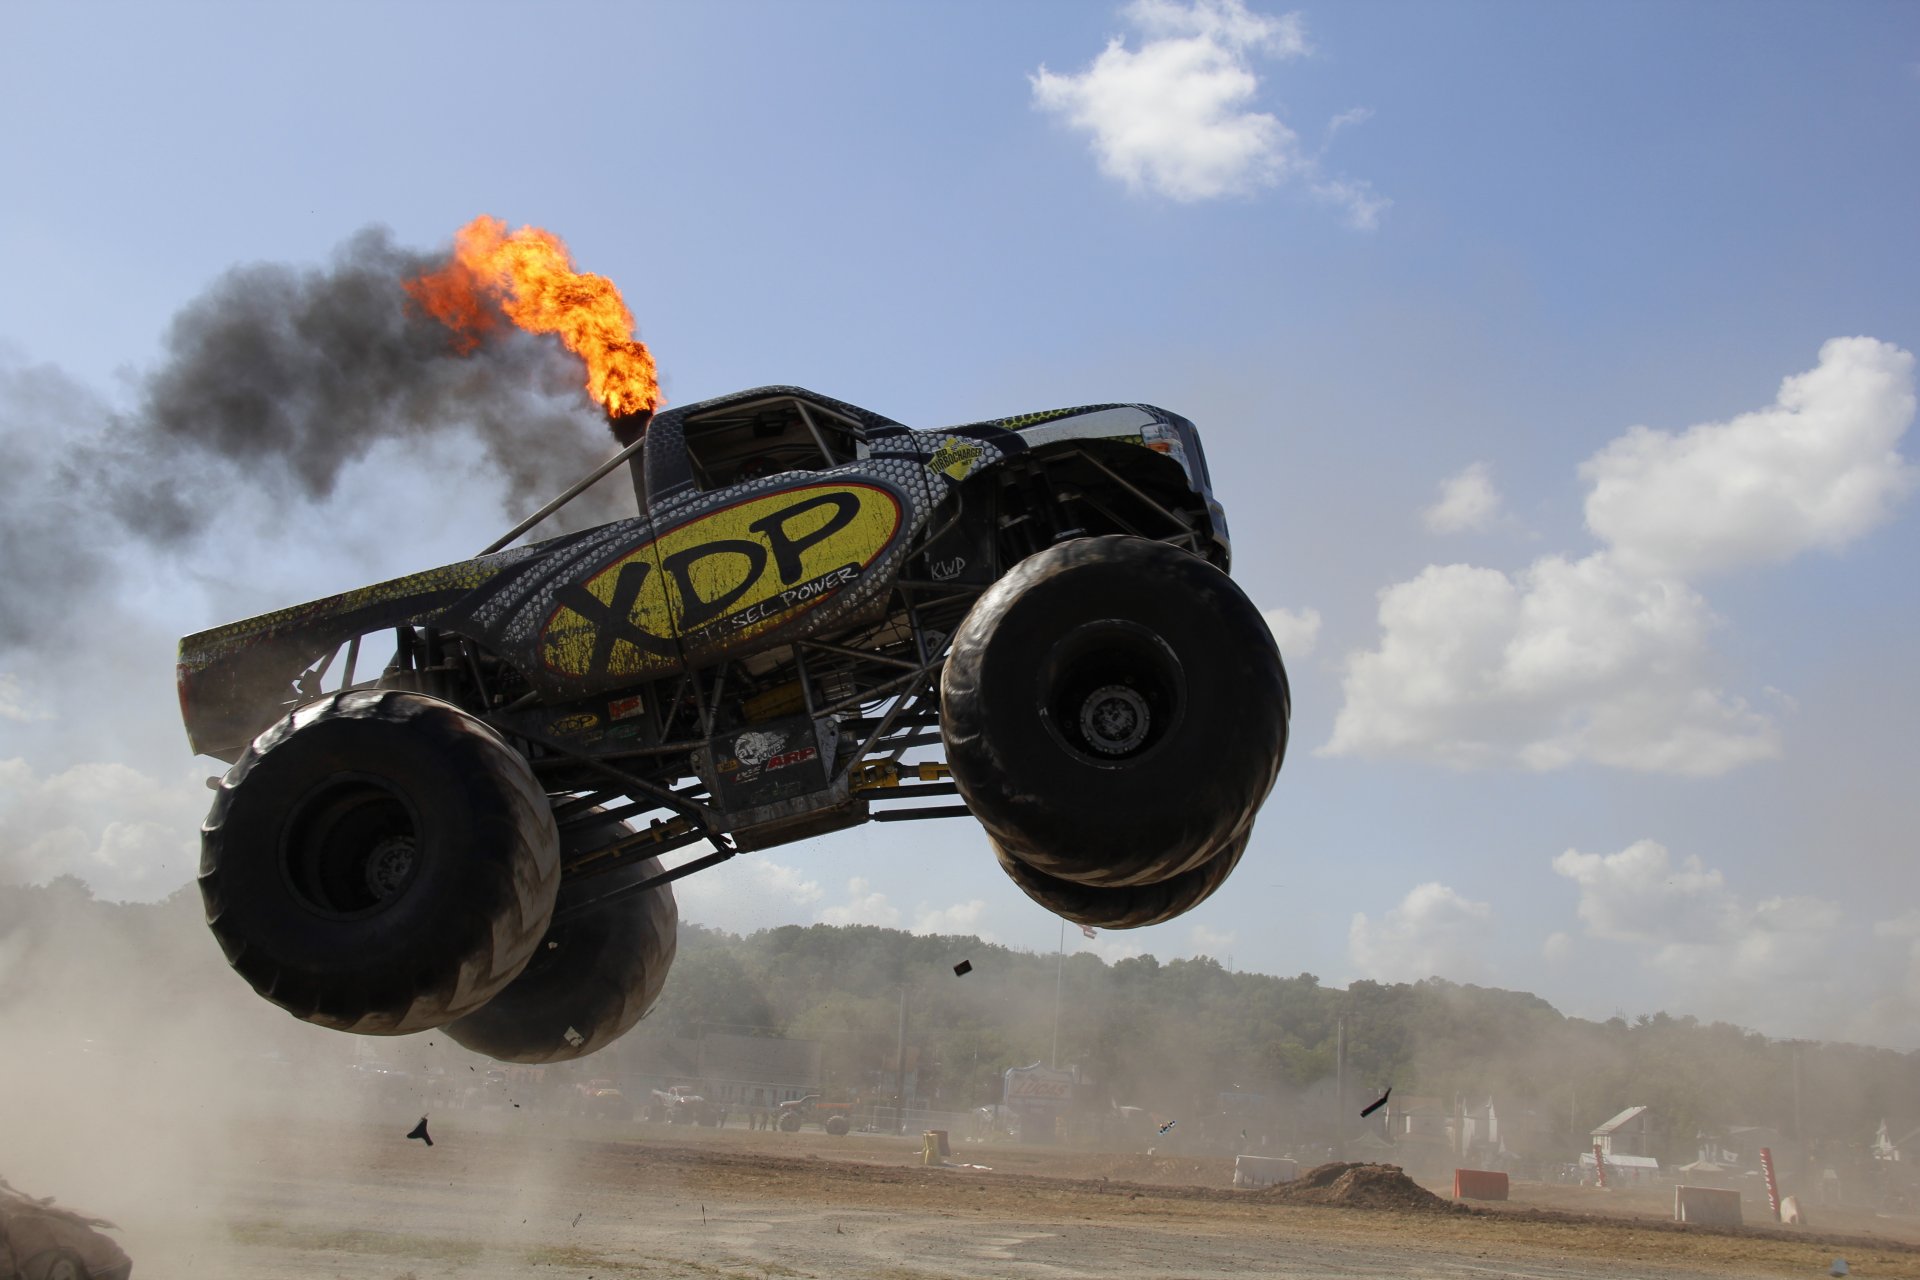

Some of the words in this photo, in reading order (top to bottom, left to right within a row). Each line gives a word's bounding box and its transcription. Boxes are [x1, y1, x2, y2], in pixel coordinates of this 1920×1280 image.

[552, 491, 861, 676] XDP
[779, 566, 861, 607] POWER
[931, 556, 966, 589] KWP
[764, 747, 817, 772] ARP
